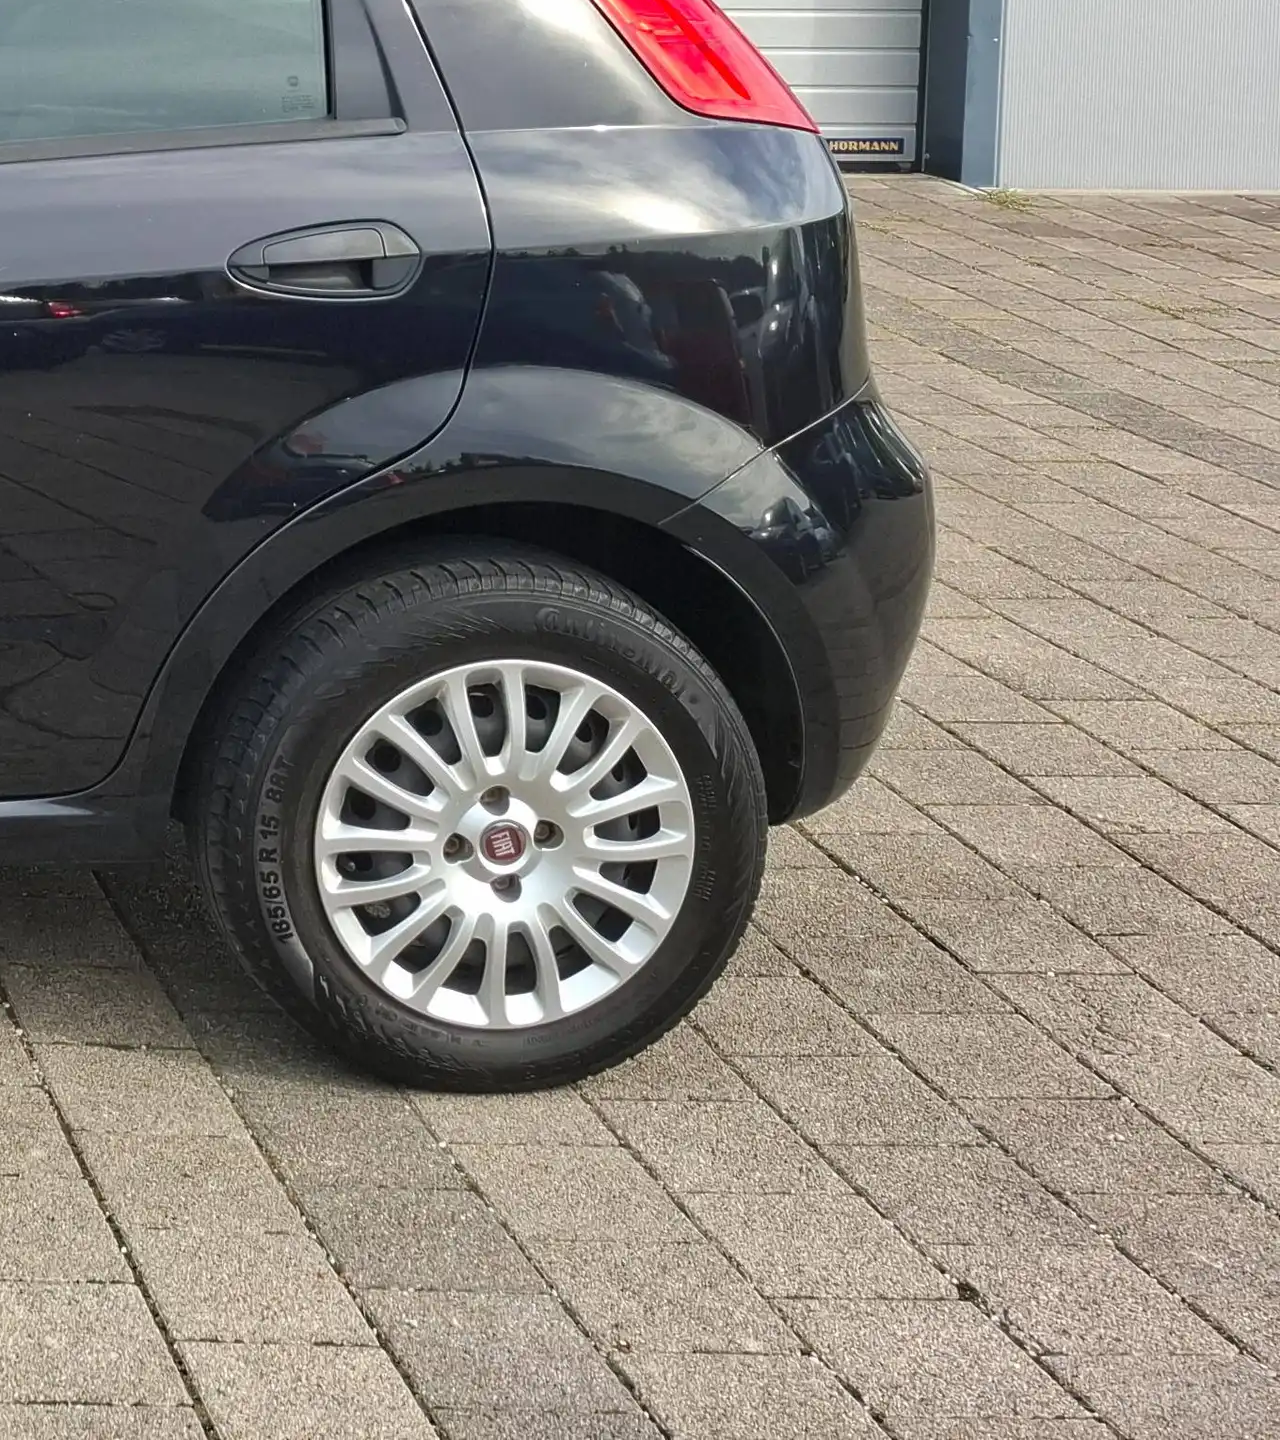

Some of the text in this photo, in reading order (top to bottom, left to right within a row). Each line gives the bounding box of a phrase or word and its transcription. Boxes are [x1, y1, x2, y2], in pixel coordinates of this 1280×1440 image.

[259, 813, 280, 841] 15
[258, 847, 279, 864] R
[491, 830, 515, 857] FIAT
